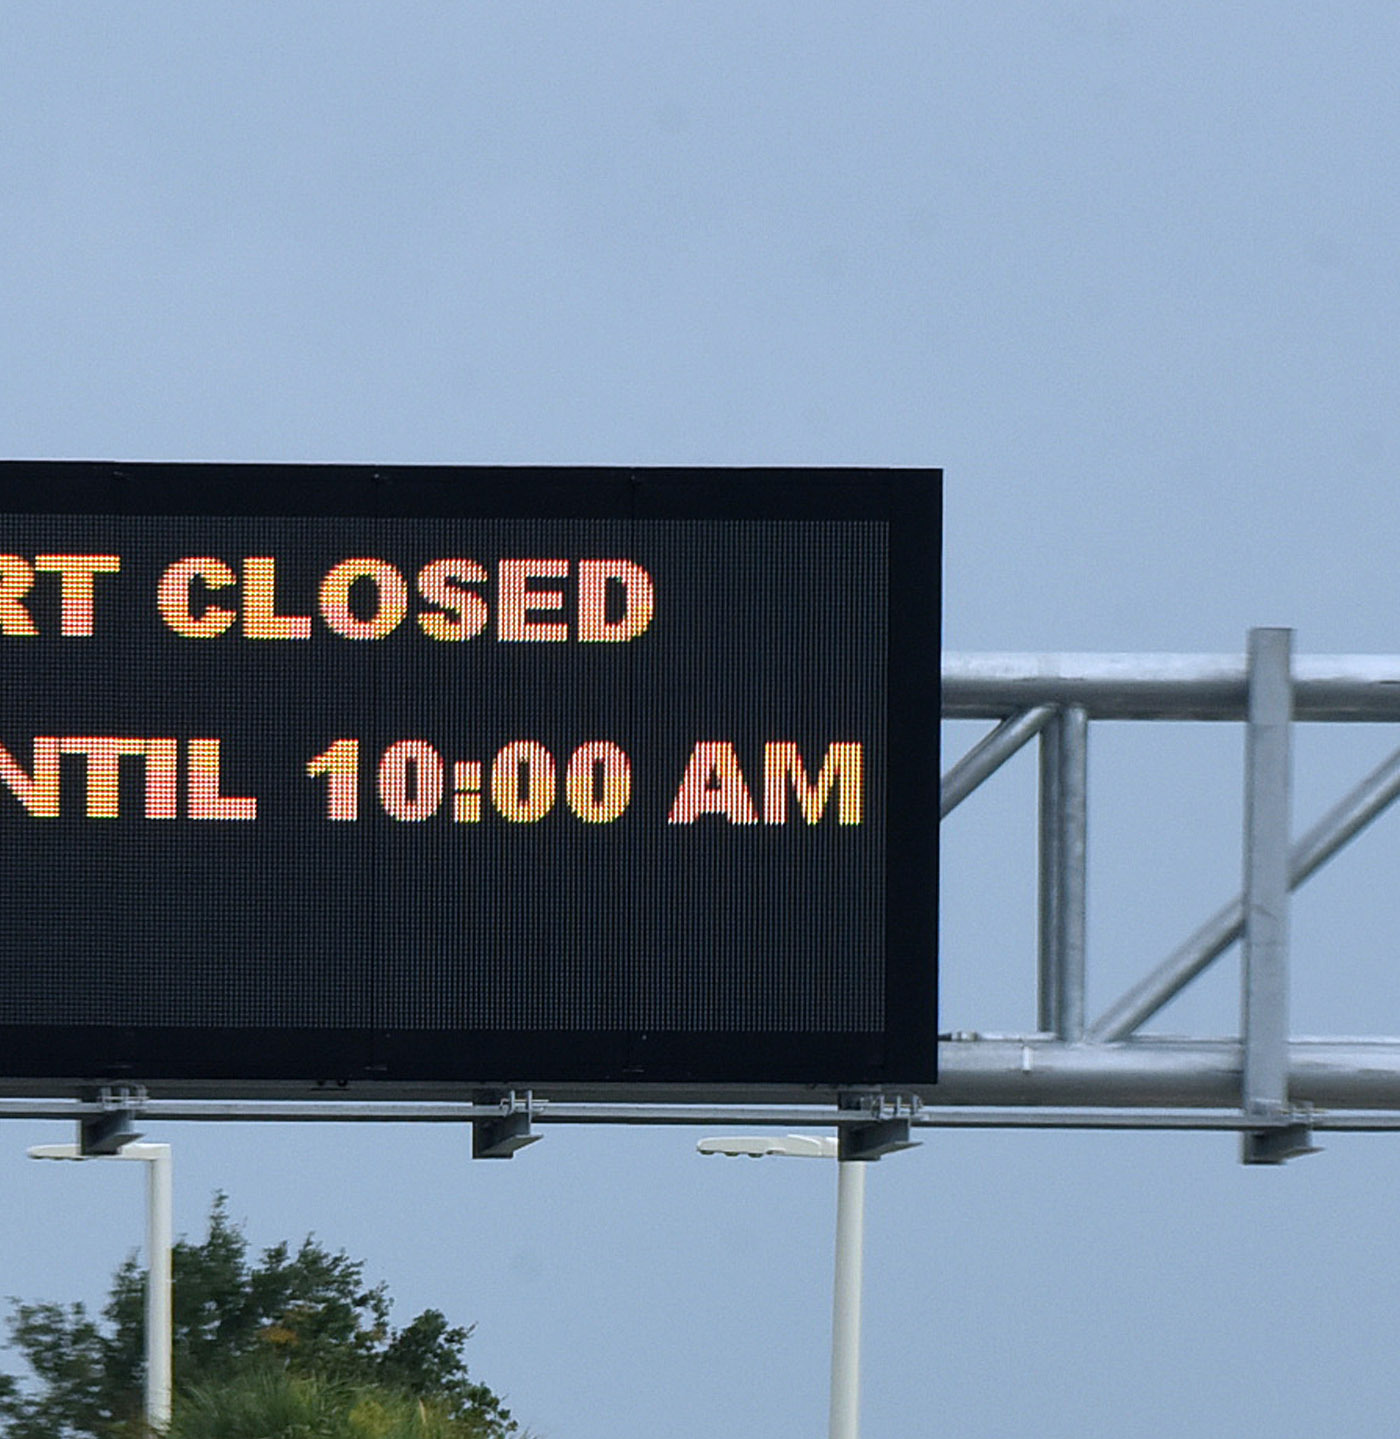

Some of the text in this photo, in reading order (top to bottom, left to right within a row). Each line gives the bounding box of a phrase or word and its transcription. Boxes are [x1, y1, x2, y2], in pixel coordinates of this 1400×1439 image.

[156, 556, 655, 643] CLOSED
[306, 738, 632, 824] 10:00
[667, 741, 864, 826] AM
